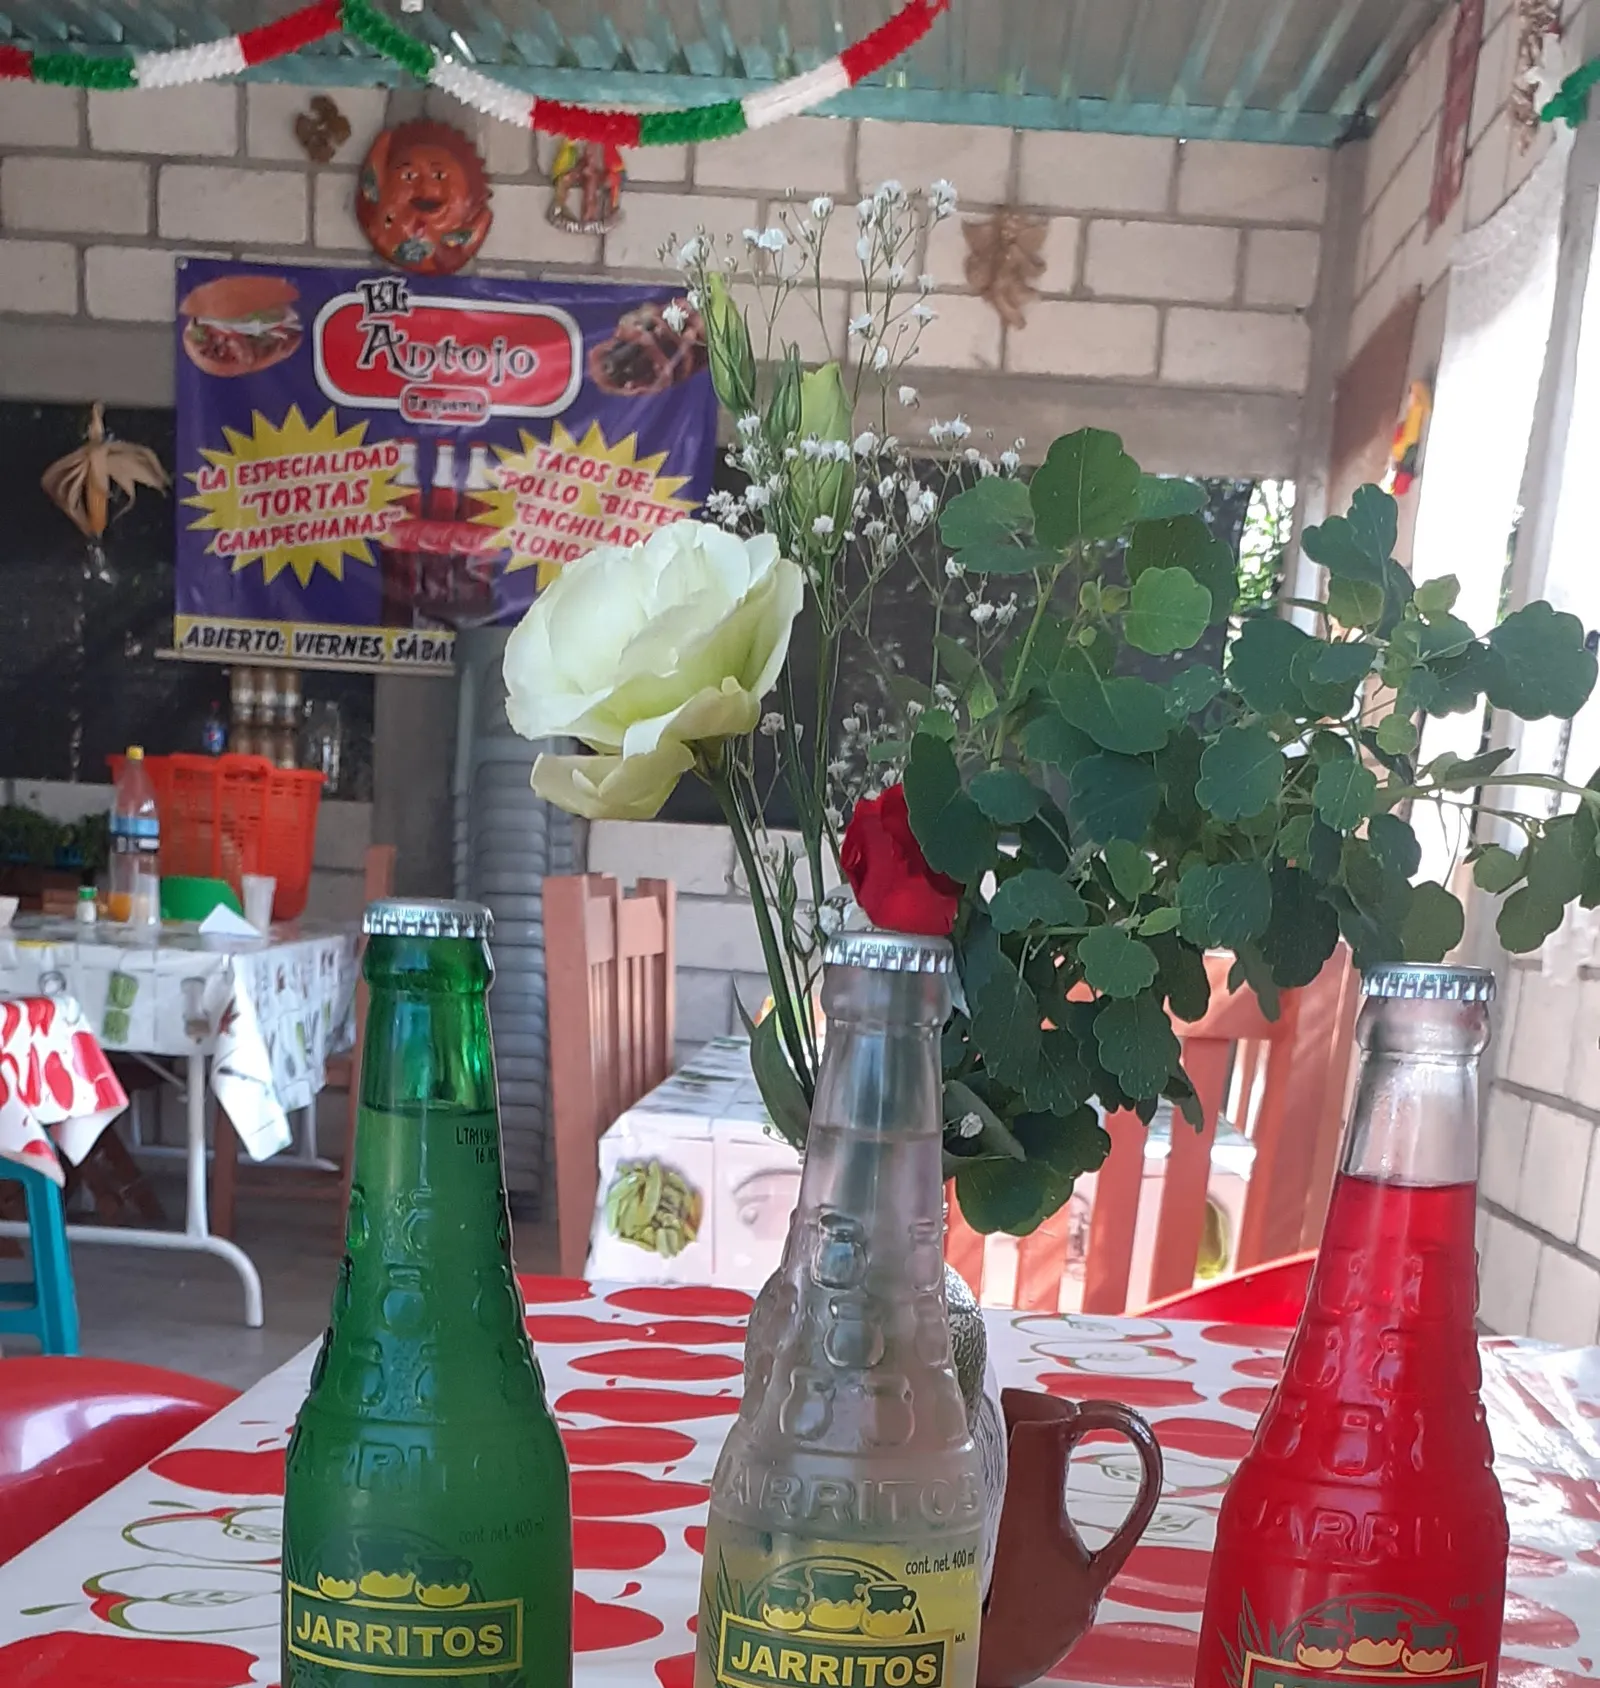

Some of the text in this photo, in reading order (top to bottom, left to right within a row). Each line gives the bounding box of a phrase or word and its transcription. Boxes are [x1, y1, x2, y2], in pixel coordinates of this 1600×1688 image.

[360, 323, 536, 383] Antojo
[200, 445, 399, 491] LA ESPECIALIDAD
[535, 448, 611, 483] TACOS
[394, 633, 456, 662] SÁBA
[952, 1547, 967, 1569] 400
[296, 1610, 504, 1658] JARRITOS
[731, 1640, 937, 1687] JARRITOS
